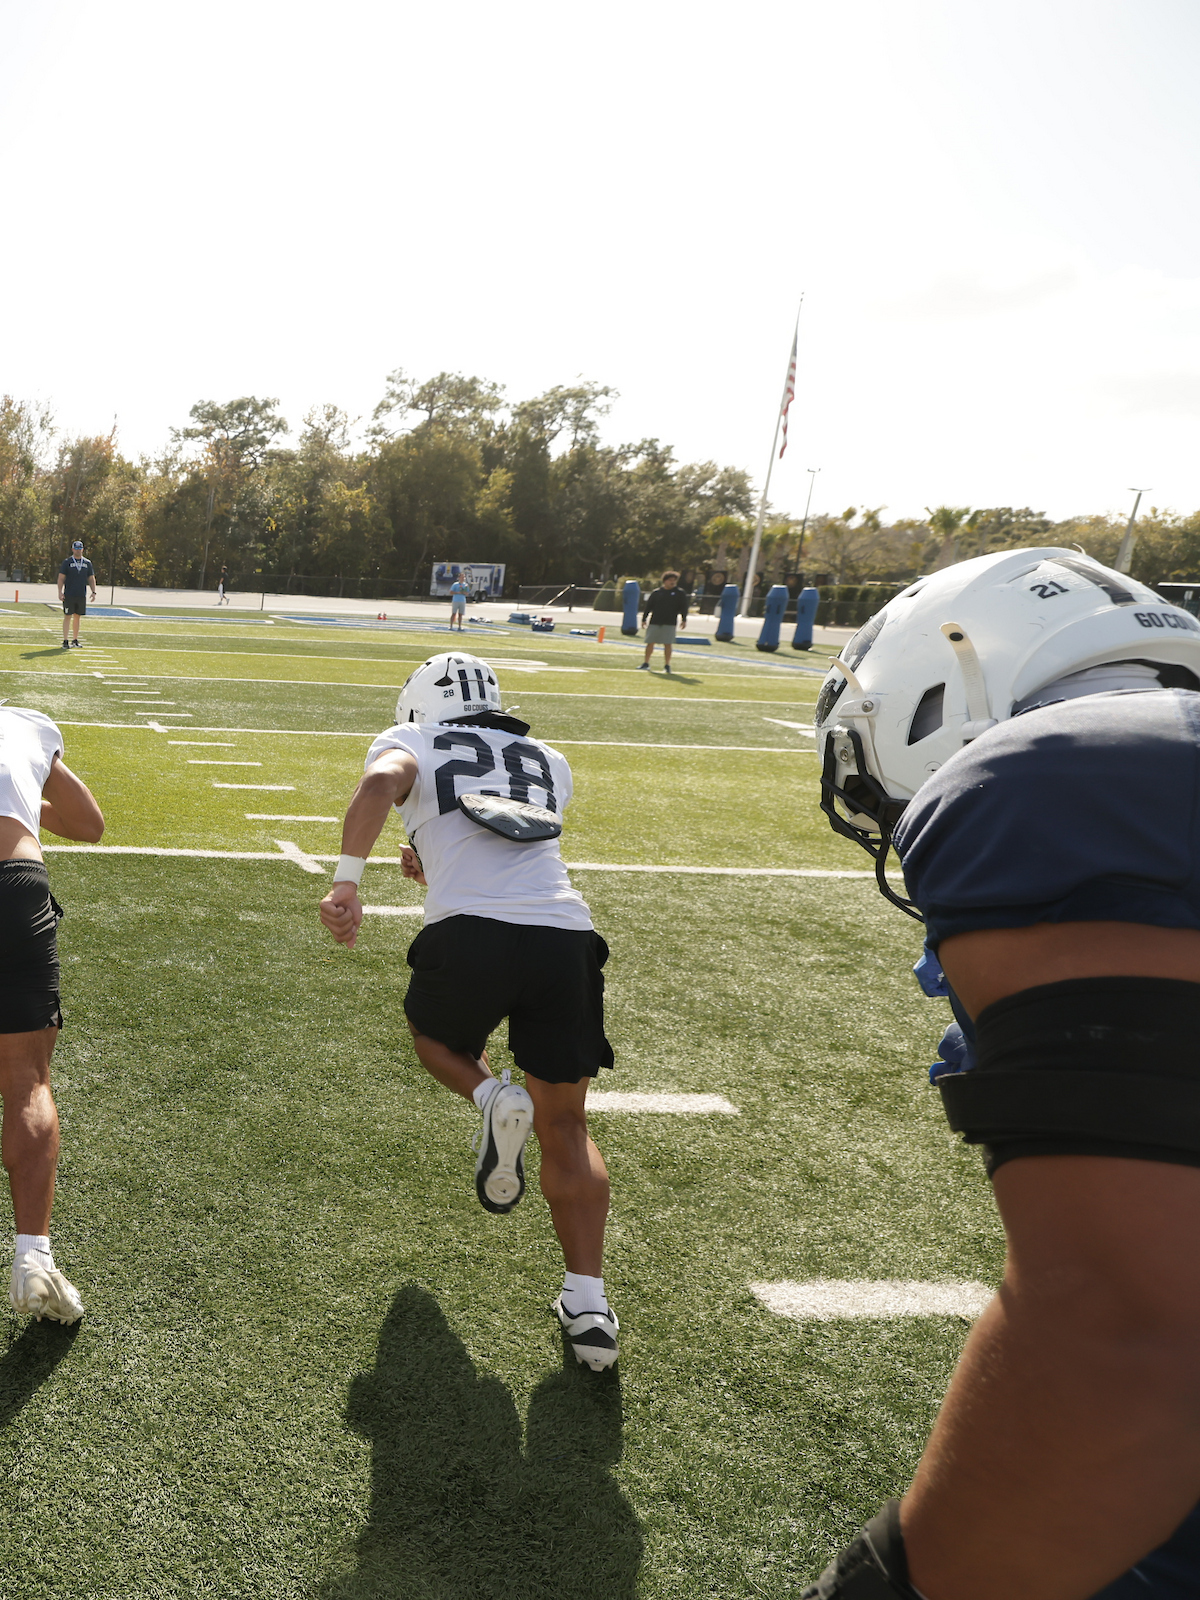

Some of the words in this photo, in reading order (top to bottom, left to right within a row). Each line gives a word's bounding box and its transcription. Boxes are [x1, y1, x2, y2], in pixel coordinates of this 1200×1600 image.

[1030, 580, 1070, 600] 21
[1133, 612, 1165, 628] GO
[443, 689, 454, 698] 28
[464, 704, 471, 712] GO
[472, 704, 489, 712] COUGS
[433, 731, 557, 816] 28
